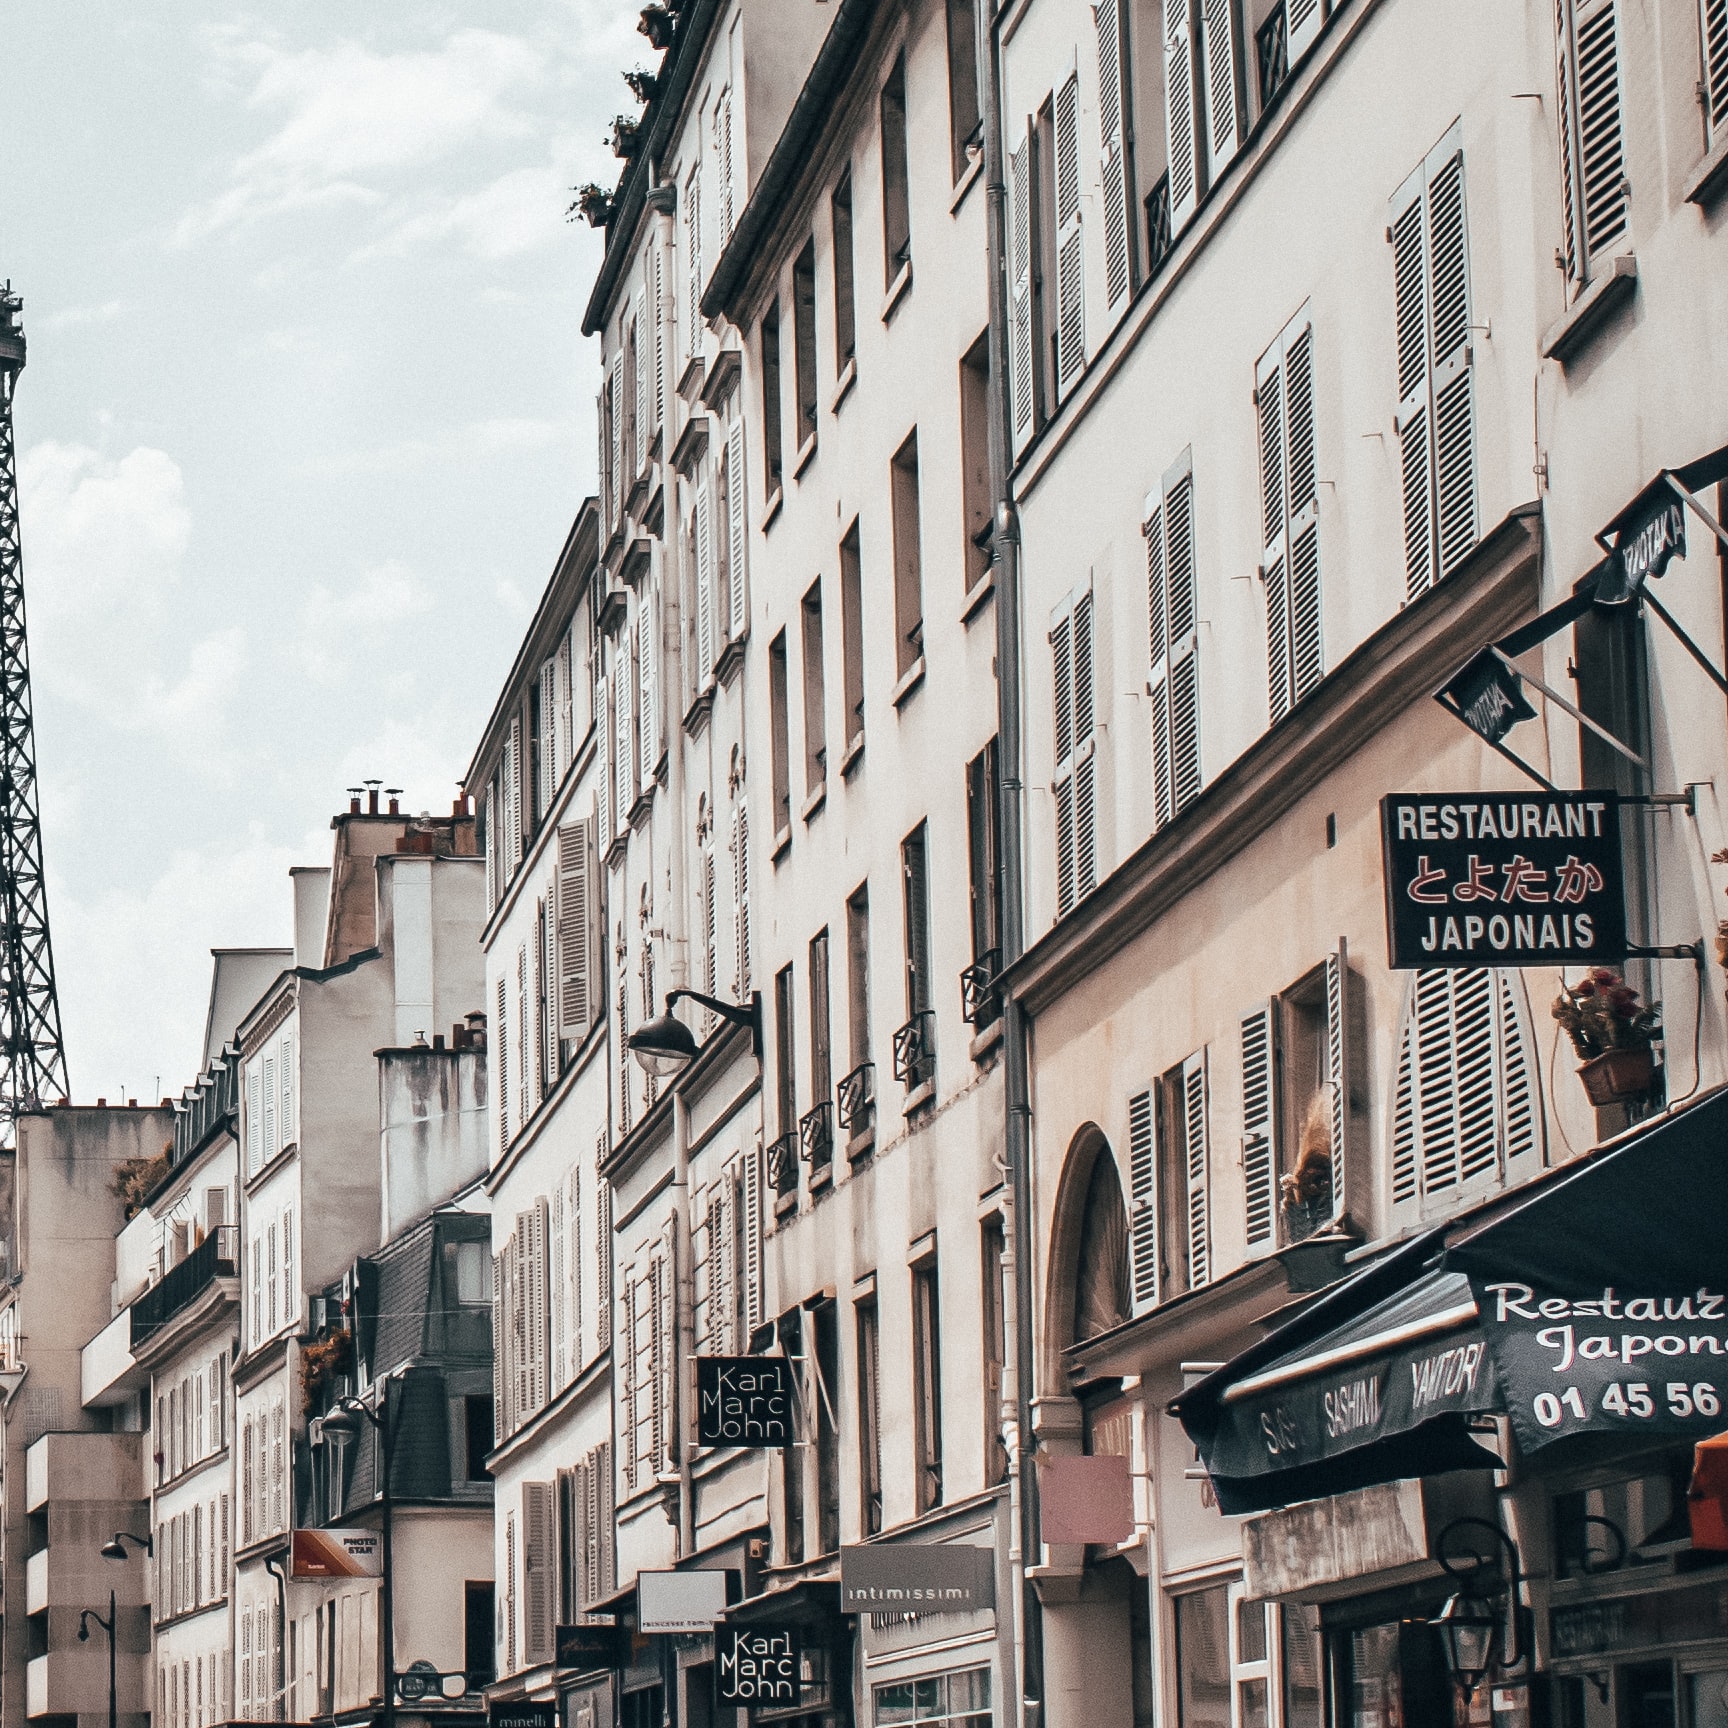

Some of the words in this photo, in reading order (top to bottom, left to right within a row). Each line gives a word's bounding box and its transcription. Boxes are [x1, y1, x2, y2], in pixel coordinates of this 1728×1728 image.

[1397, 802, 1605, 840] RESTAURANT
[1407, 854, 1604, 904] とよたか
[1421, 913, 1595, 952] JAPONAIS
[1536, 1324, 1728, 1372] Japon
[717, 1366, 785, 1392] Karl
[703, 1389, 784, 1415] Marc
[1533, 1385, 1586, 1427] 01
[1602, 1382, 1655, 1418] 45
[1666, 1382, 1721, 1417] 56
[704, 1412, 785, 1438] John
[343, 1538, 378, 1546] PHOTO
[348, 1546, 373, 1554] STAR
[848, 1587, 970, 1600] intimissimi
[734, 1631, 793, 1656] Karl
[721, 1652, 792, 1676] Marc
[722, 1673, 792, 1698] John
[499, 1714, 546, 1728] minelli
